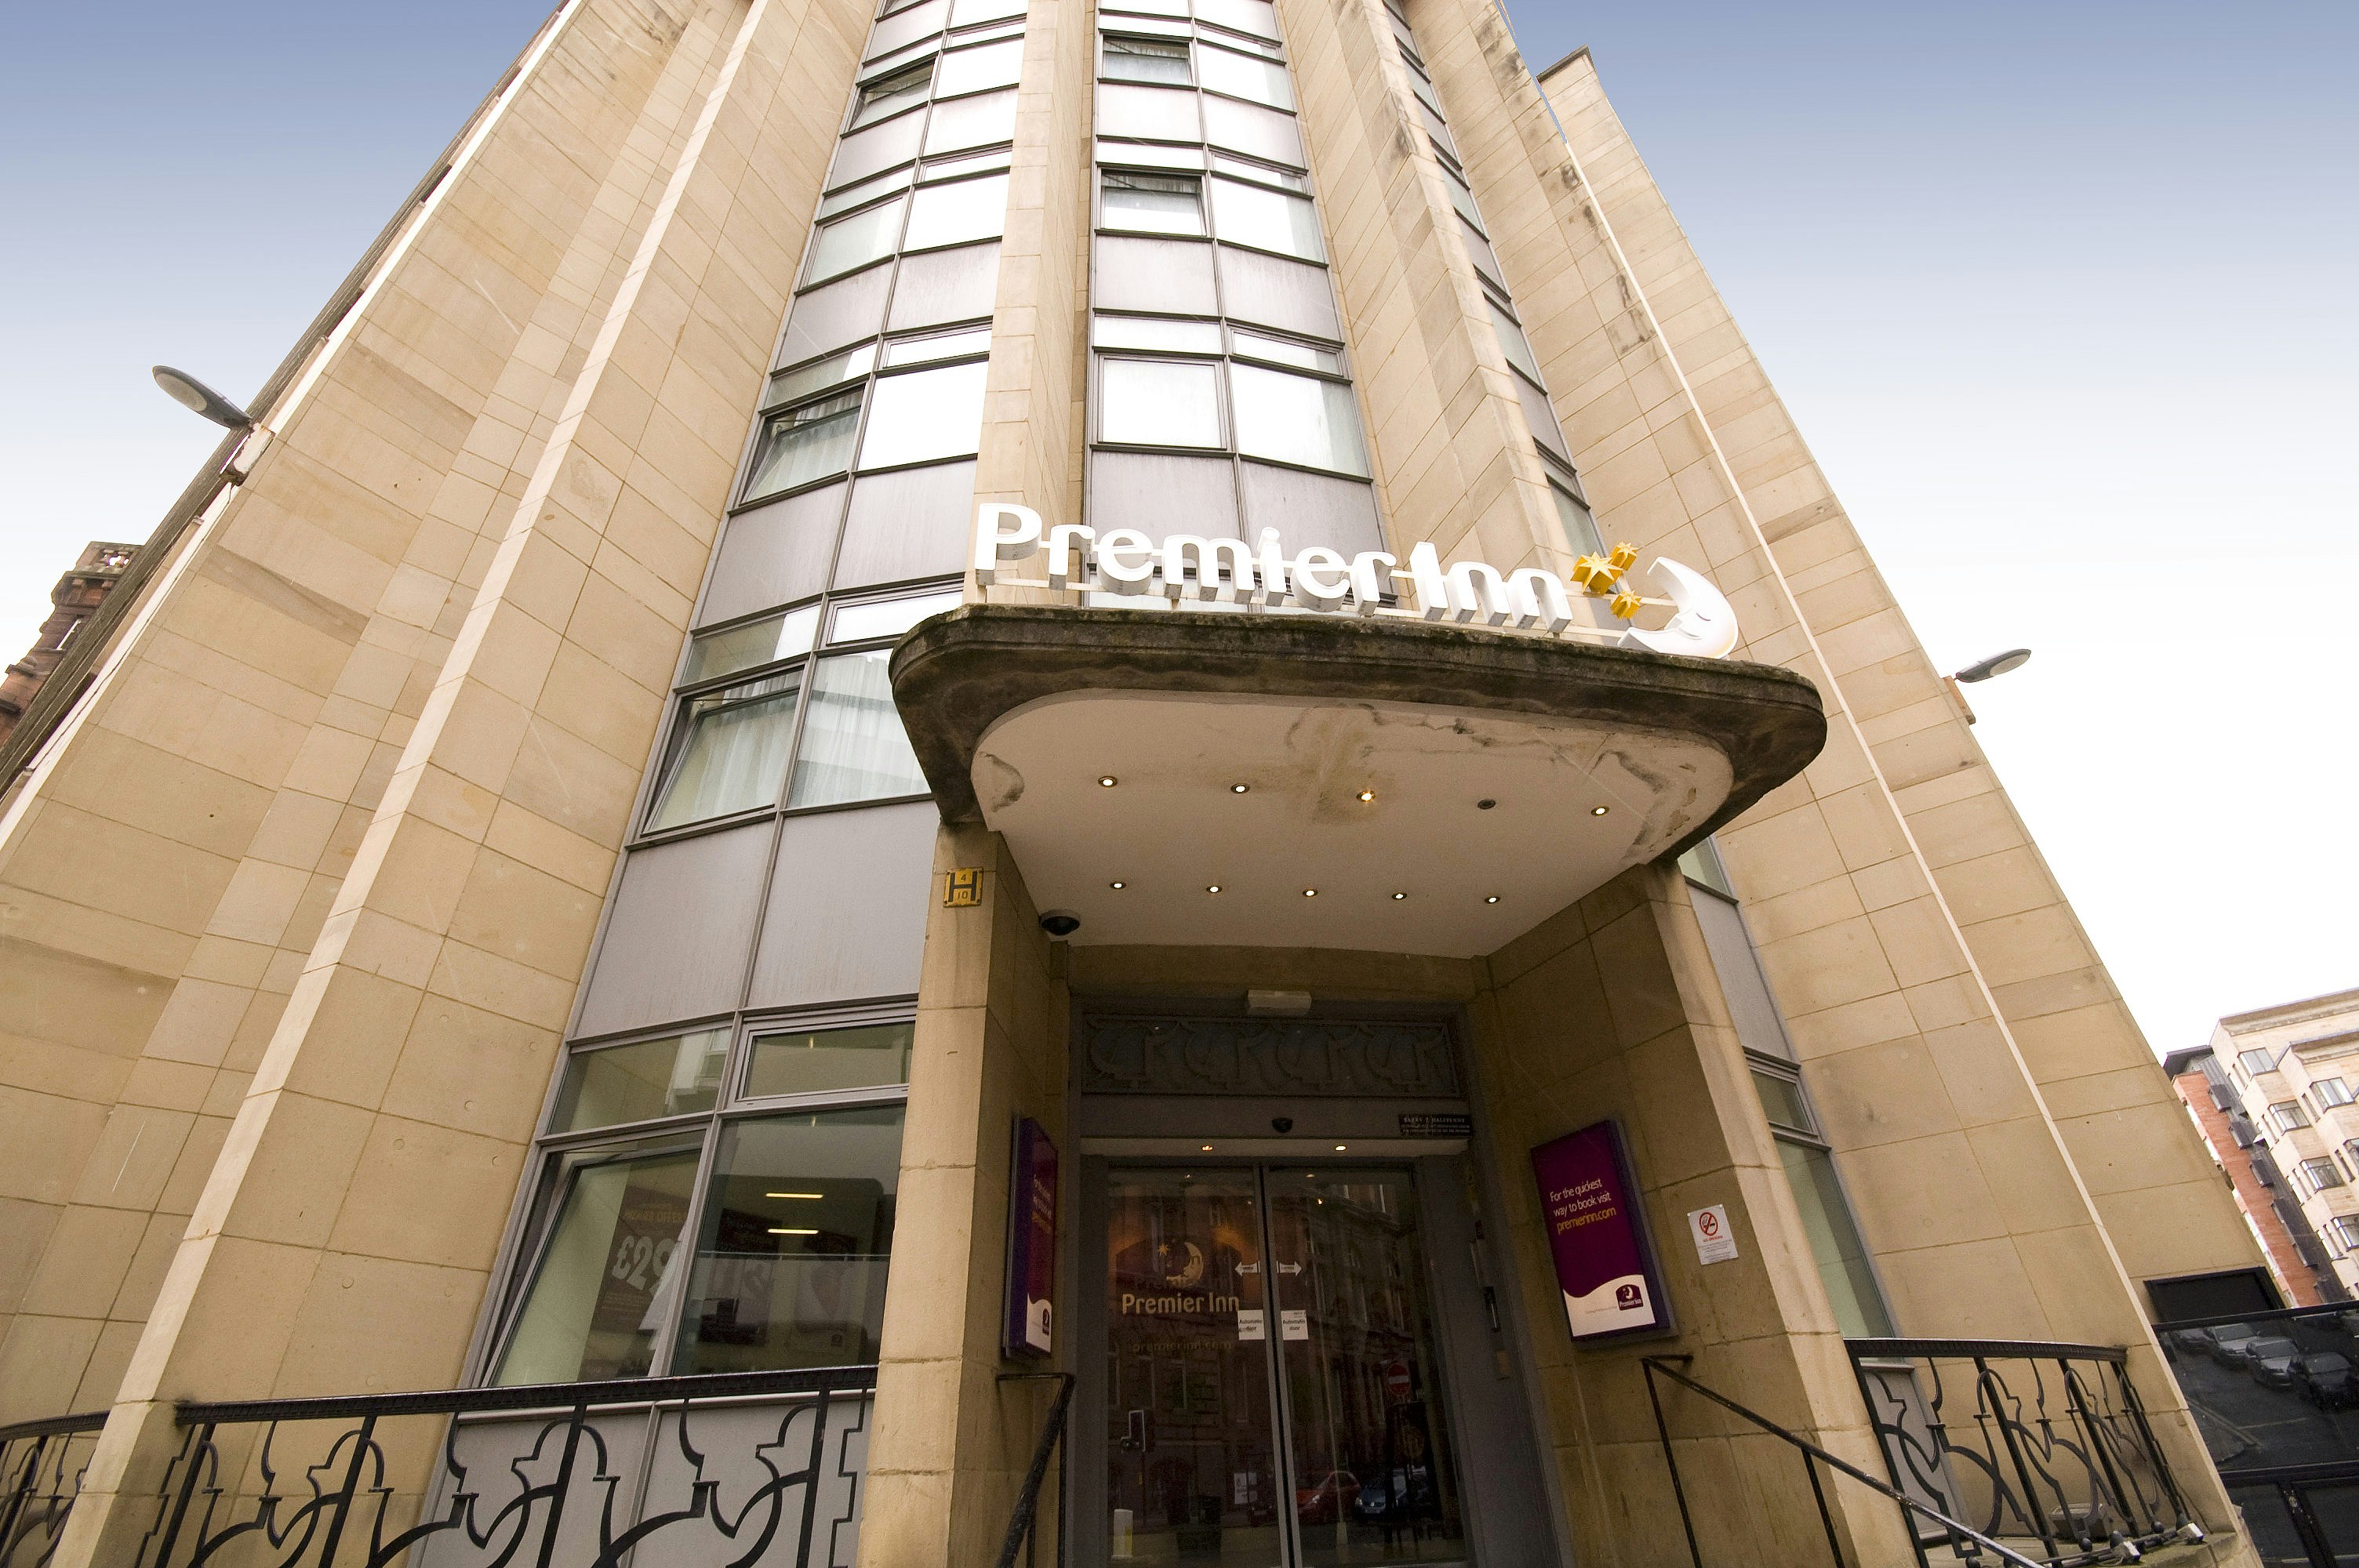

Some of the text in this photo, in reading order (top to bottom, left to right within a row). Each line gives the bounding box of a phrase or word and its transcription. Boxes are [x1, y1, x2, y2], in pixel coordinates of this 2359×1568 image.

[973, 503, 1572, 633] Premier Inn
[1550, 1178, 1603, 1203] For the quickest
[1553, 1190, 1612, 1218] way to book visit
[1556, 1206, 1617, 1236] premierinn.com
[1121, 1291, 1239, 1315] Premier Inn
